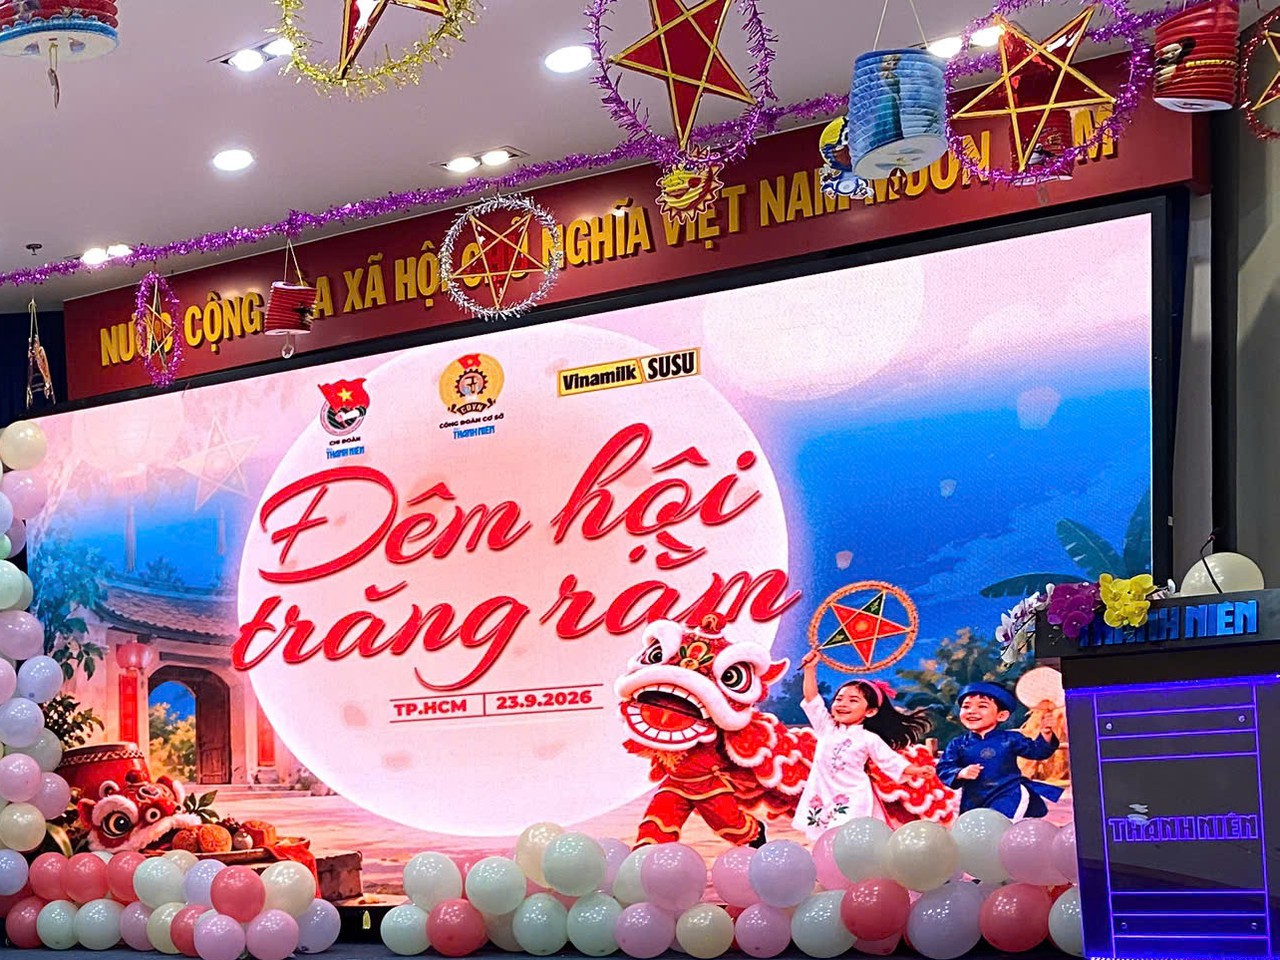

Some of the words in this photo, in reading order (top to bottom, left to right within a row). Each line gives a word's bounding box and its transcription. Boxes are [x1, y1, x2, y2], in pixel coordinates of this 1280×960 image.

[184, 291, 263, 352] CỘNG
[343, 252, 387, 312] XÃ
[542, 198, 651, 269] NGHĨA
[562, 360, 637, 391] Vinamilk
[647, 351, 695, 380] SUSU
[258, 465, 531, 584] Đêm
[550, 422, 764, 563] hội
[230, 581, 530, 691] trăng
[540, 531, 801, 639] rằm
[1184, 599, 1257, 638] NIÊN
[394, 699, 468, 718] TP.HCM
[496, 690, 592, 712] 23.9.2026
[1108, 815, 1197, 842] THANH
[1197, 812, 1258, 840] NIÊN
